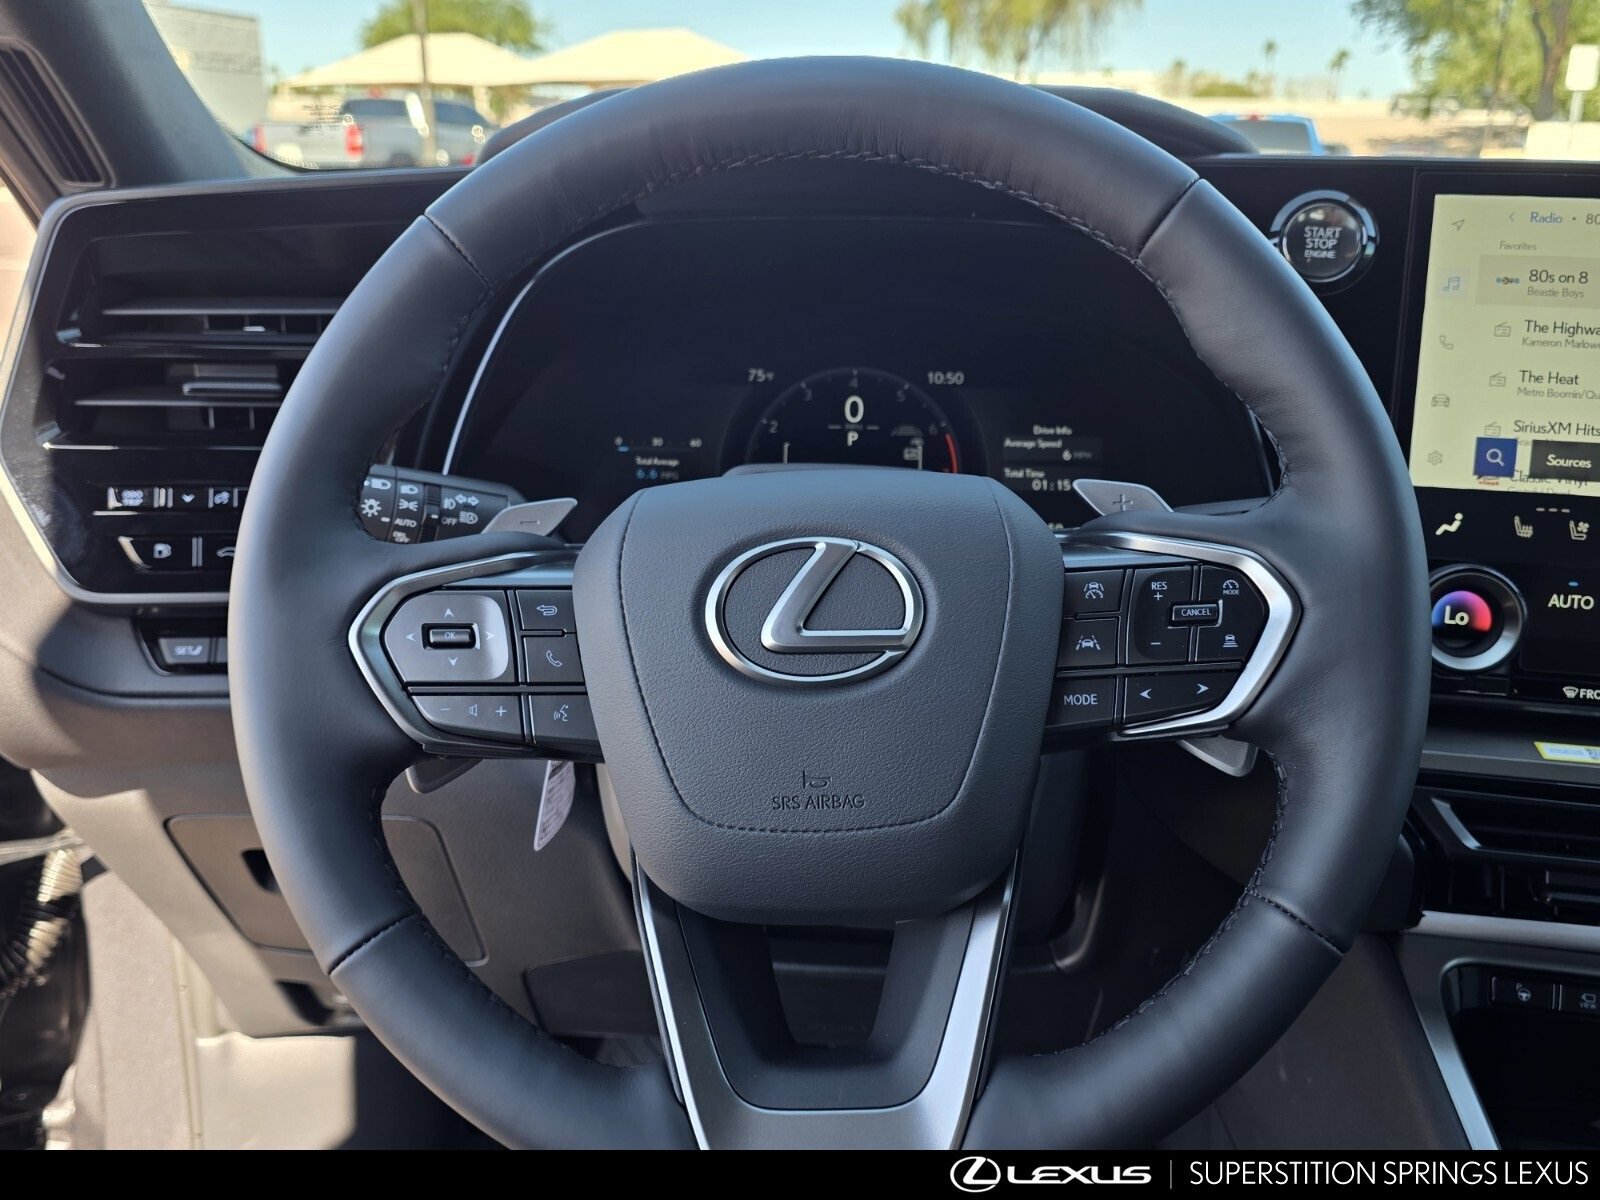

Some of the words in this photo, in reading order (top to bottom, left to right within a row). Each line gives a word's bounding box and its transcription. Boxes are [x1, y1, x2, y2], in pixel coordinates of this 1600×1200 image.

[1530, 211, 1563, 224] Radio
[1304, 226, 1342, 239] START
[1305, 238, 1338, 250] STOP
[1499, 240, 1537, 251] Favorites
[1304, 249, 1337, 259] ENGINE
[1529, 269, 1555, 283] 80s
[1558, 274, 1575, 284] on
[1578, 271, 1589, 284] 8
[1527, 286, 1559, 298] Beastie
[1562, 287, 1584, 299] Boys
[1524, 319, 1549, 334] The
[1521, 337, 1562, 348] Kameron
[927, 370, 965, 386] 10:50
[1519, 370, 1543, 384] The
[1548, 371, 1579, 386] Heat
[1517, 386, 1545, 398] Metro
[844, 394, 864, 424] 0
[1033, 424, 1055, 435] Drive
[1512, 420, 1572, 435] SiriusXM
[847, 431, 859, 446] P
[1004, 438, 1037, 450] Average
[1037, 438, 1063, 449] Speed
[1546, 453, 1592, 469] Sources
[1004, 467, 1024, 479] Total
[1025, 468, 1046, 479] Time
[394, 517, 417, 528] AUTO
[1151, 581, 1168, 591] RES
[1222, 588, 1240, 596] MODE
[1548, 593, 1595, 610] AUTO
[1180, 607, 1212, 617] CANCEL
[1444, 605, 1470, 626] Lo
[444, 631, 456, 640] OK
[1063, 694, 1098, 706] MODE
[772, 795, 801, 811] SRS
[804, 794, 865, 810] AIRBAG
